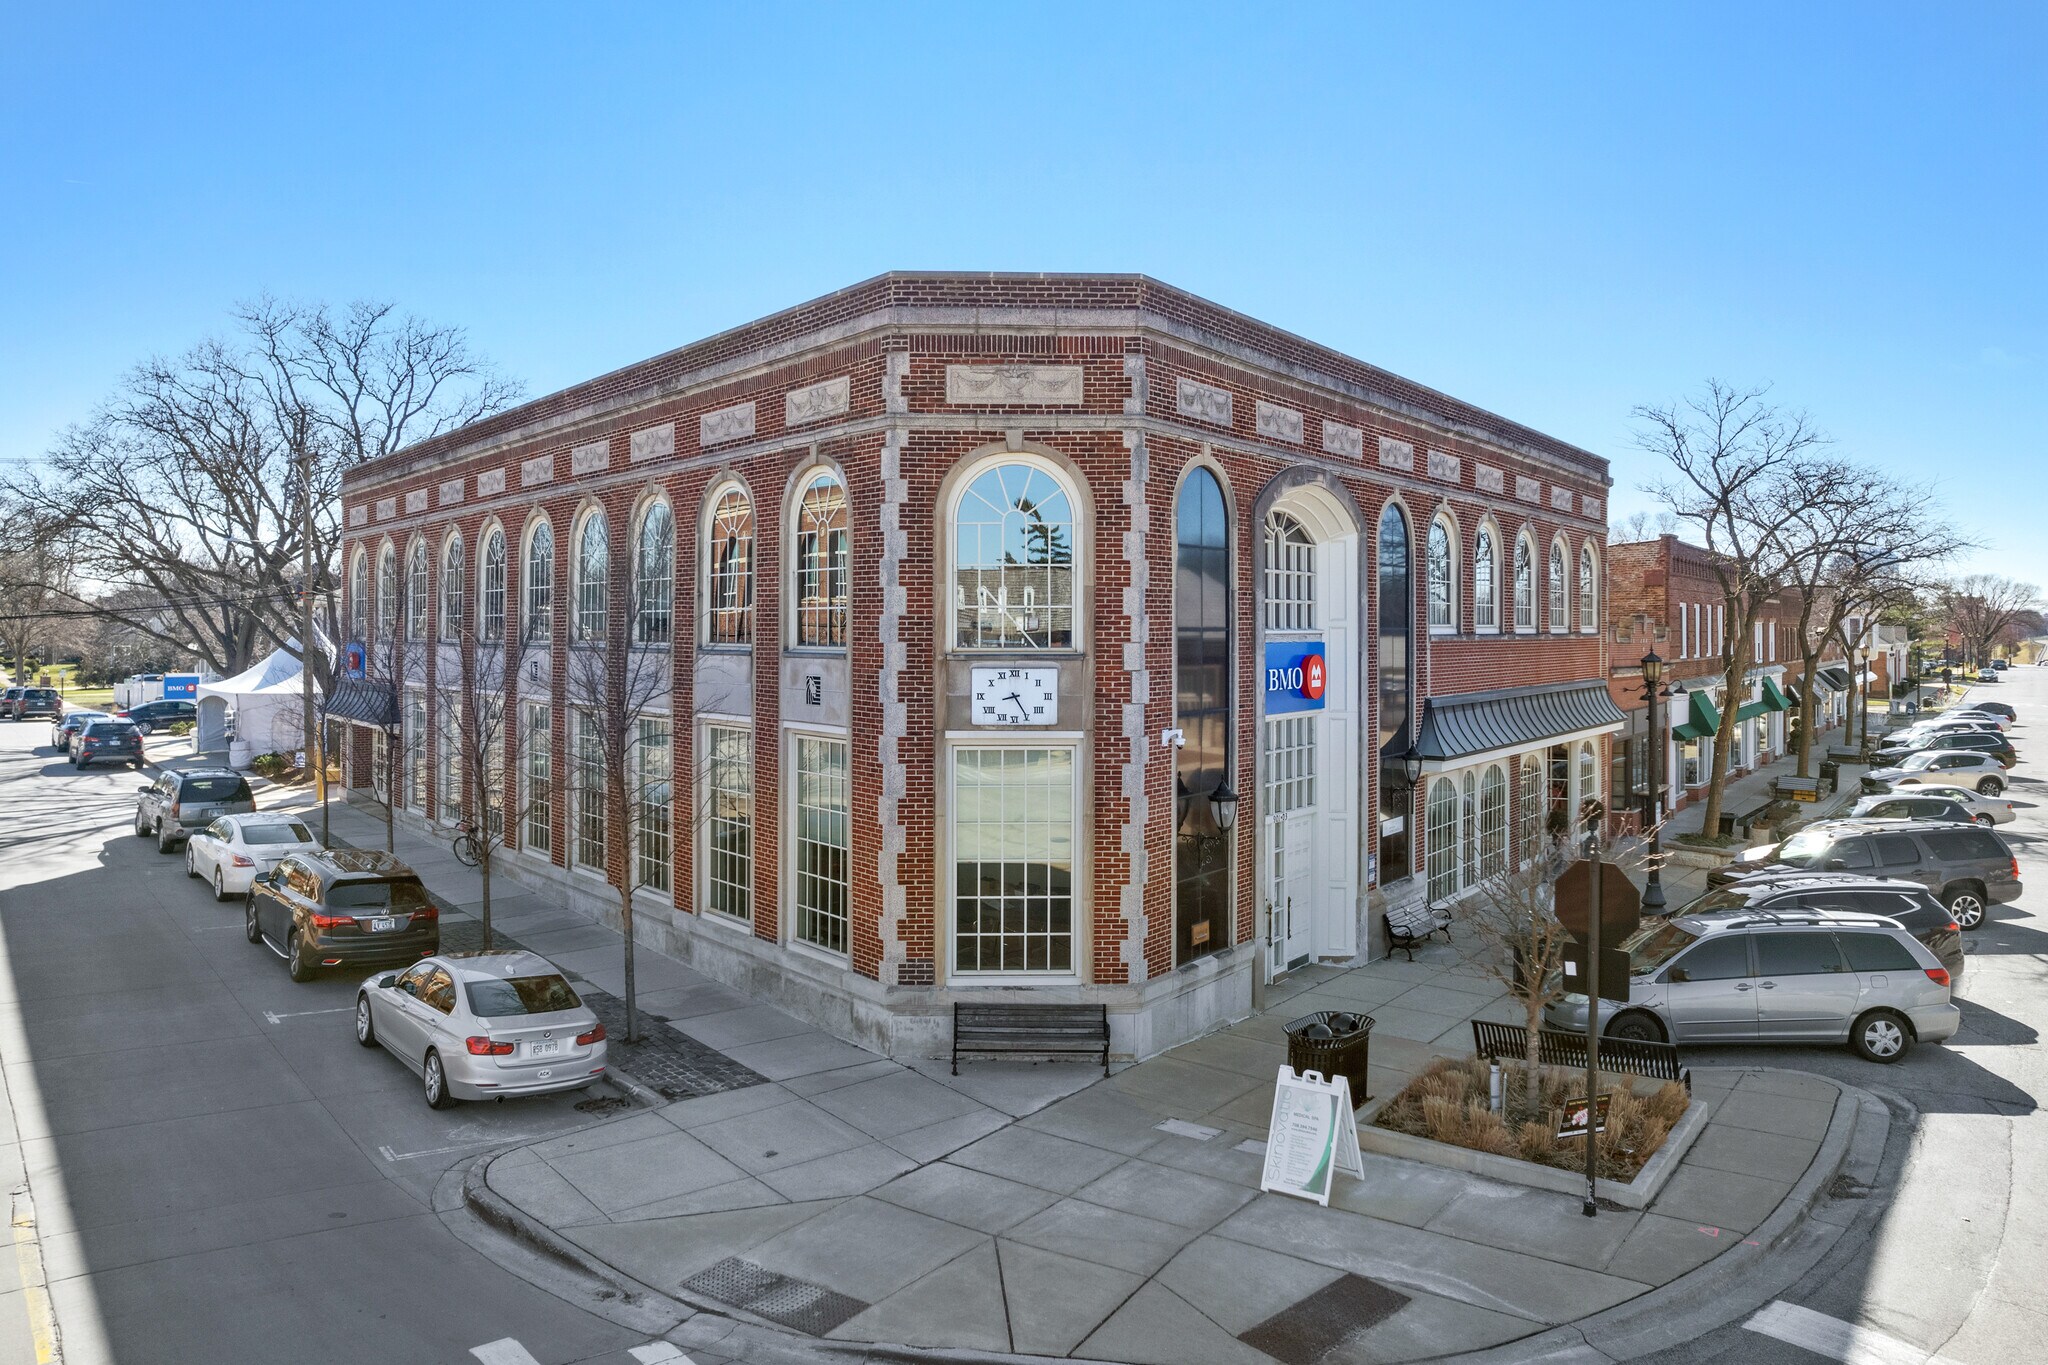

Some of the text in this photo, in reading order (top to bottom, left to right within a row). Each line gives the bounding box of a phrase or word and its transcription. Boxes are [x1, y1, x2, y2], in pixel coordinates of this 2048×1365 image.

[988, 679, 995, 687] X
[1035, 679, 1041, 687] II
[1268, 667, 1304, 691] BMO
[983, 706, 995, 714] VIII
[1033, 706, 1044, 714] IIII
